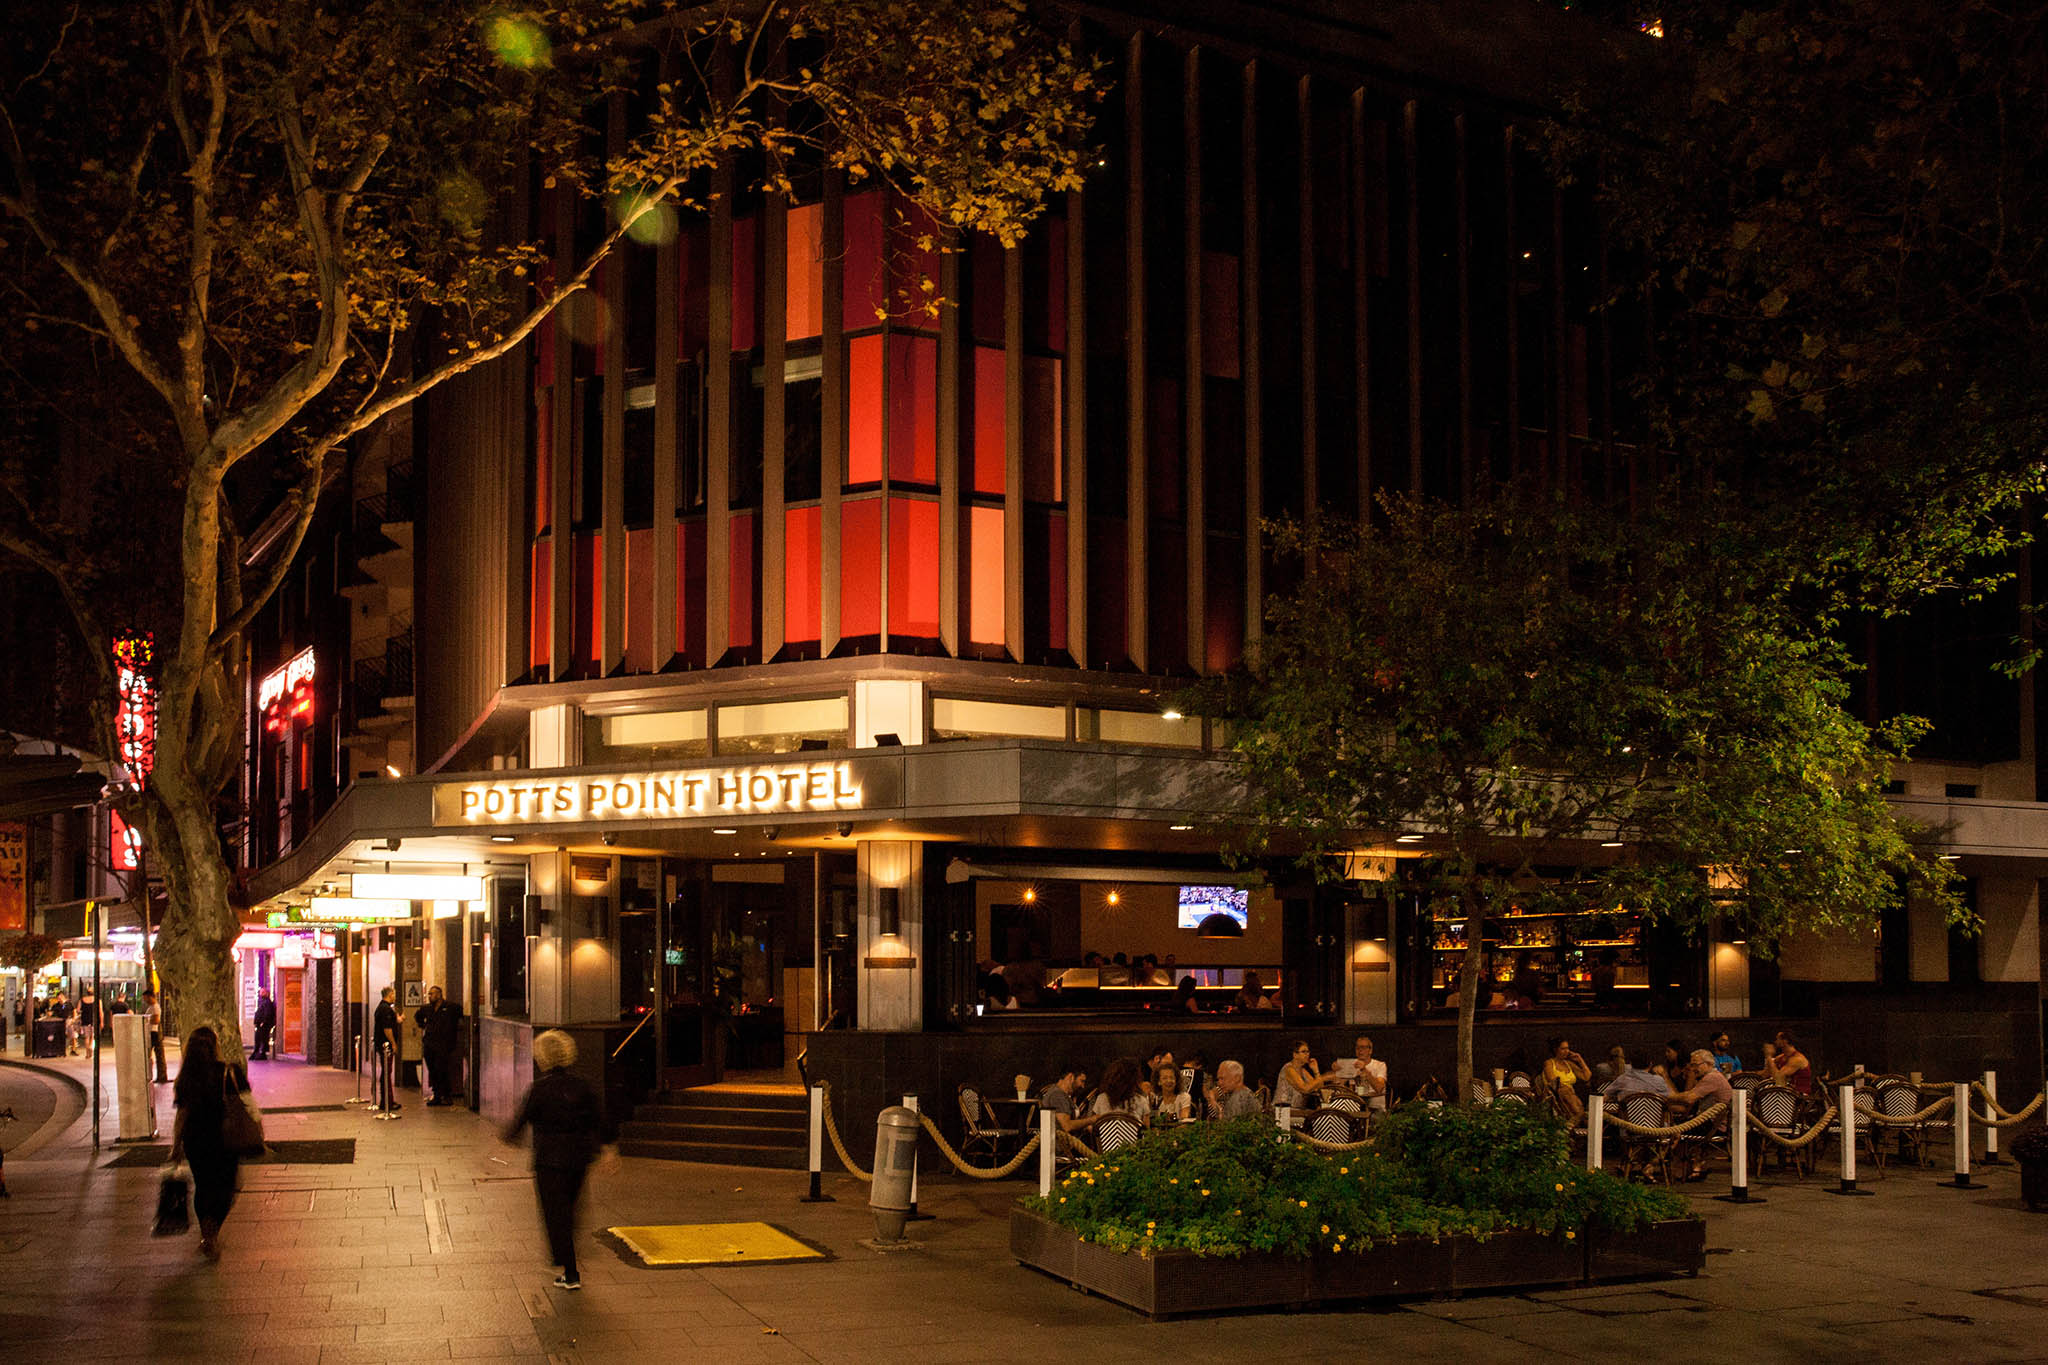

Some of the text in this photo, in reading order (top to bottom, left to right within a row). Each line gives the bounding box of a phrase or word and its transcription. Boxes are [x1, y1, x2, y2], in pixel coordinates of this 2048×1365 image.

[460, 764, 861, 818] POTTS POINT HOTEL
